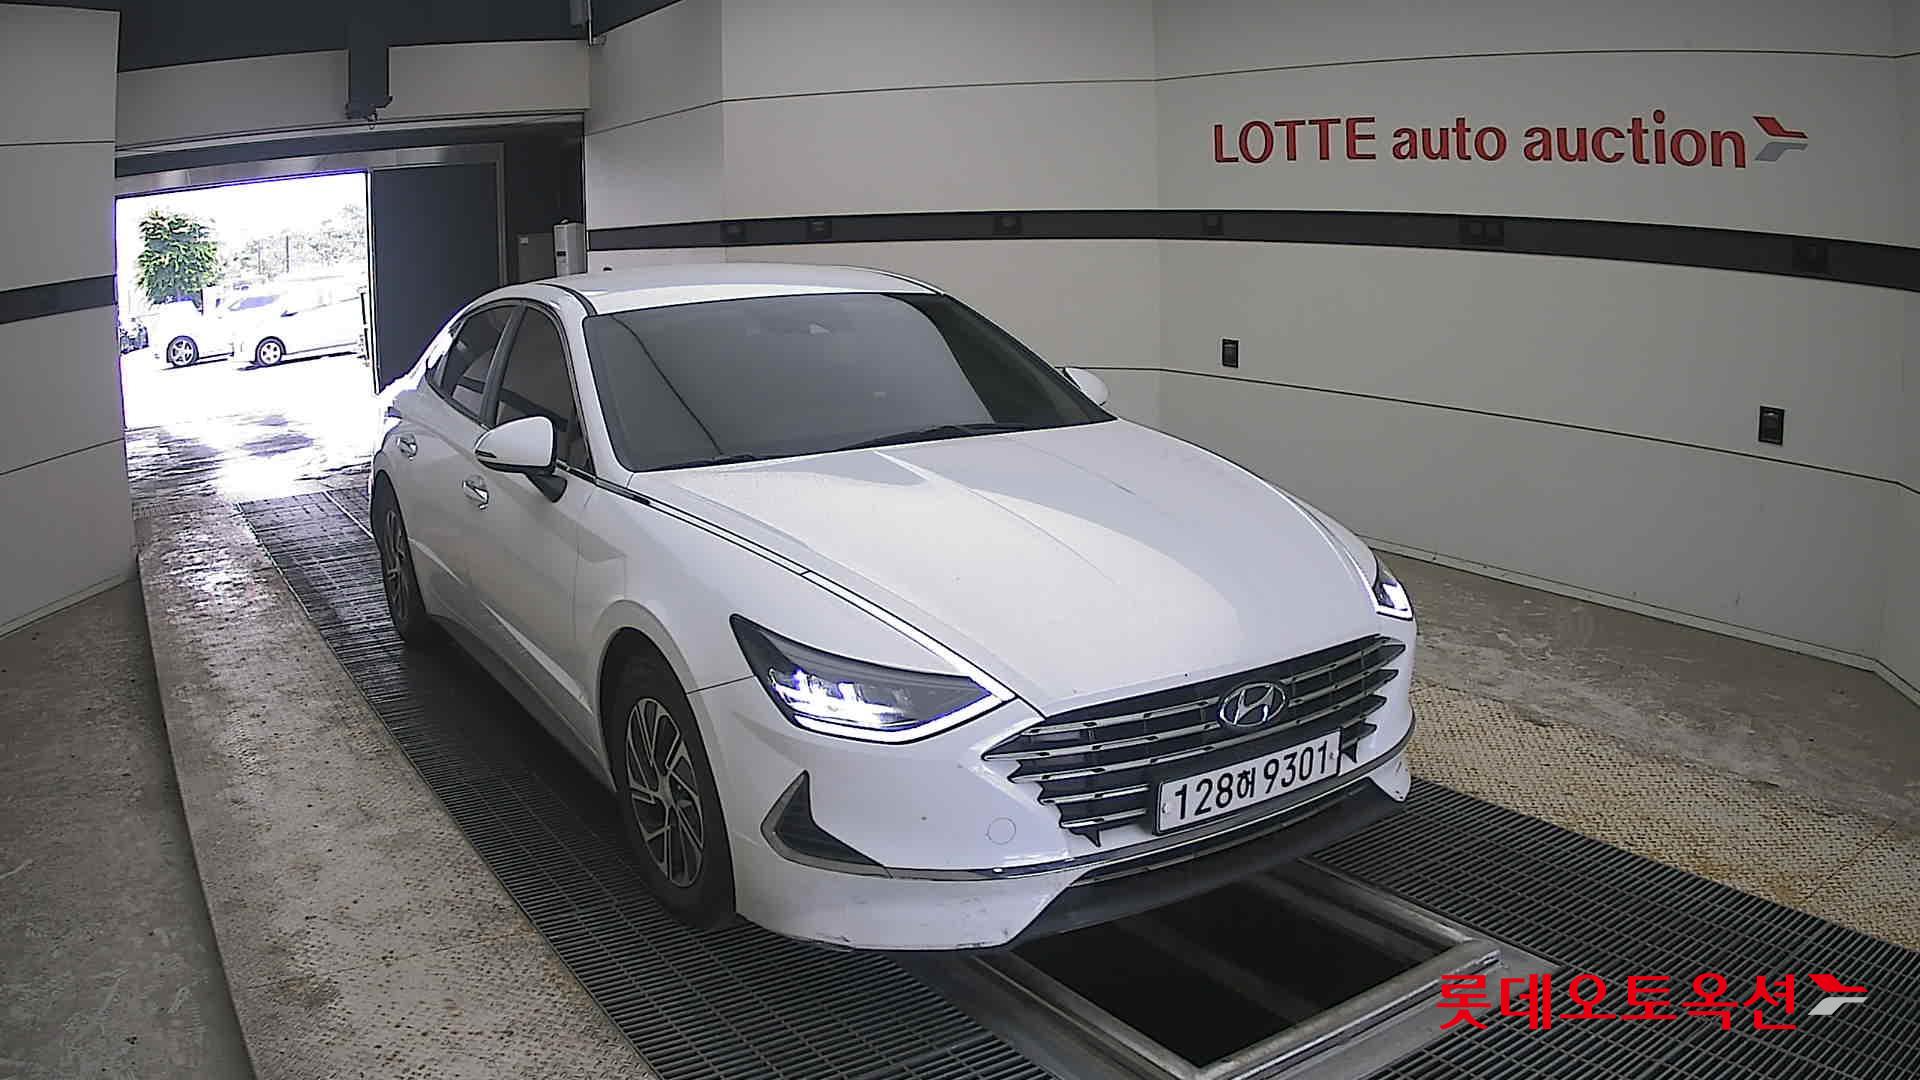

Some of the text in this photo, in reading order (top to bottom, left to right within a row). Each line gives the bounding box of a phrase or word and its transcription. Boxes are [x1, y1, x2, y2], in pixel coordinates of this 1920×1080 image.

[1213, 109, 1747, 169] LOTTE auto auction
[1175, 740, 1328, 820] 128허 9301
